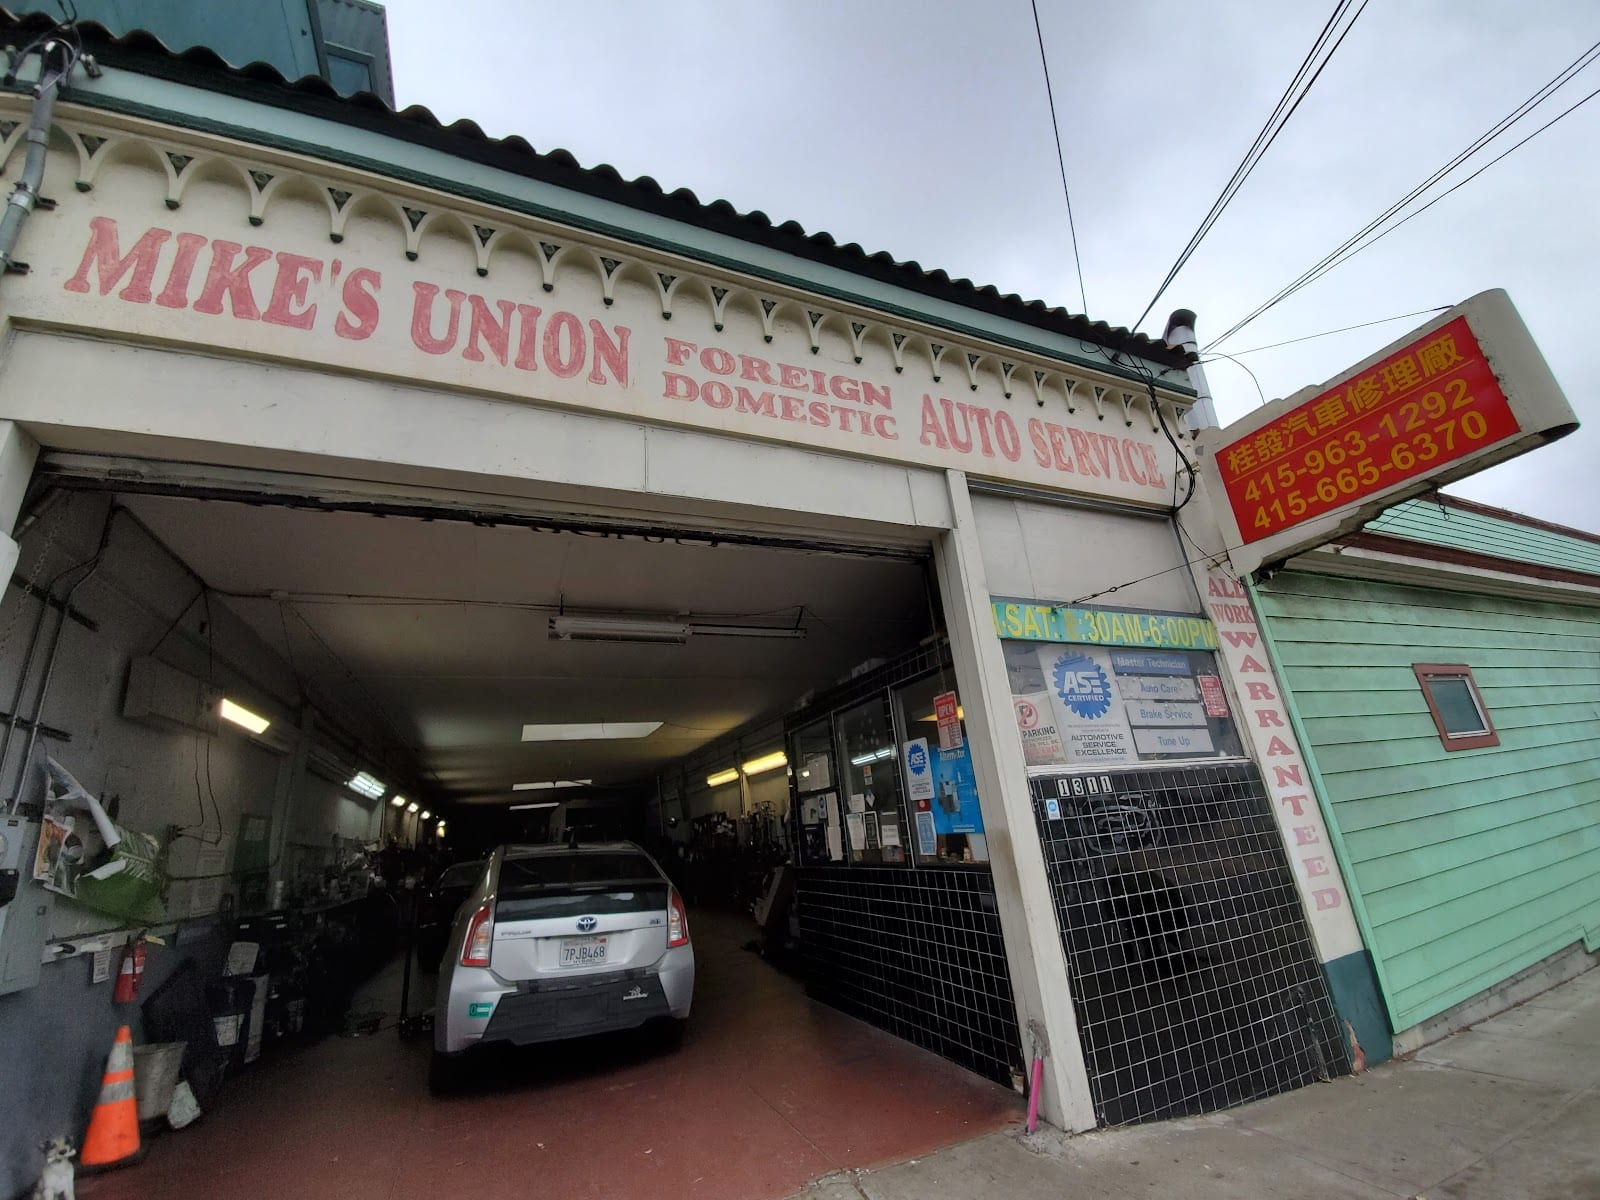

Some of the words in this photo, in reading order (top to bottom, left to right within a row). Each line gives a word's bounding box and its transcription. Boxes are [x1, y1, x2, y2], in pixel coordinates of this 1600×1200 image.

[64, 216, 382, 341] MIKE'S
[411, 281, 631, 389] UNION
[663, 337, 892, 410] FOREIGN
[663, 371, 898, 441] DOMESTIC
[1228, 333, 1464, 475] 桂發汽車修理廠
[920, 393, 1021, 463] AUTO
[1028, 418, 1166, 489] SERVICE
[1245, 379, 1475, 502] 415-963-1292
[1254, 411, 1488, 529] 415-665-6370
[1208, 576, 1248, 598] ALL
[1210, 604, 1256, 624] WORK
[1064, 672, 1103, 693] ASE
[1140, 708, 1162, 719] Brake
[1164, 709, 1193, 719] Service
[1023, 726, 1056, 738] PARKING
[1071, 733, 1124, 742] AUTOMOTIVE
[1157, 736, 1177, 746] Tune
[1180, 737, 1191, 747] Up
[1074, 747, 1128, 757] EXCELLENCE
[1082, 741, 1117, 749] SERVICE
[1220, 631, 1341, 911] WARRANTED
[1058, 775, 1113, 797] 1311
[564, 946, 605, 961] 7PJB468
